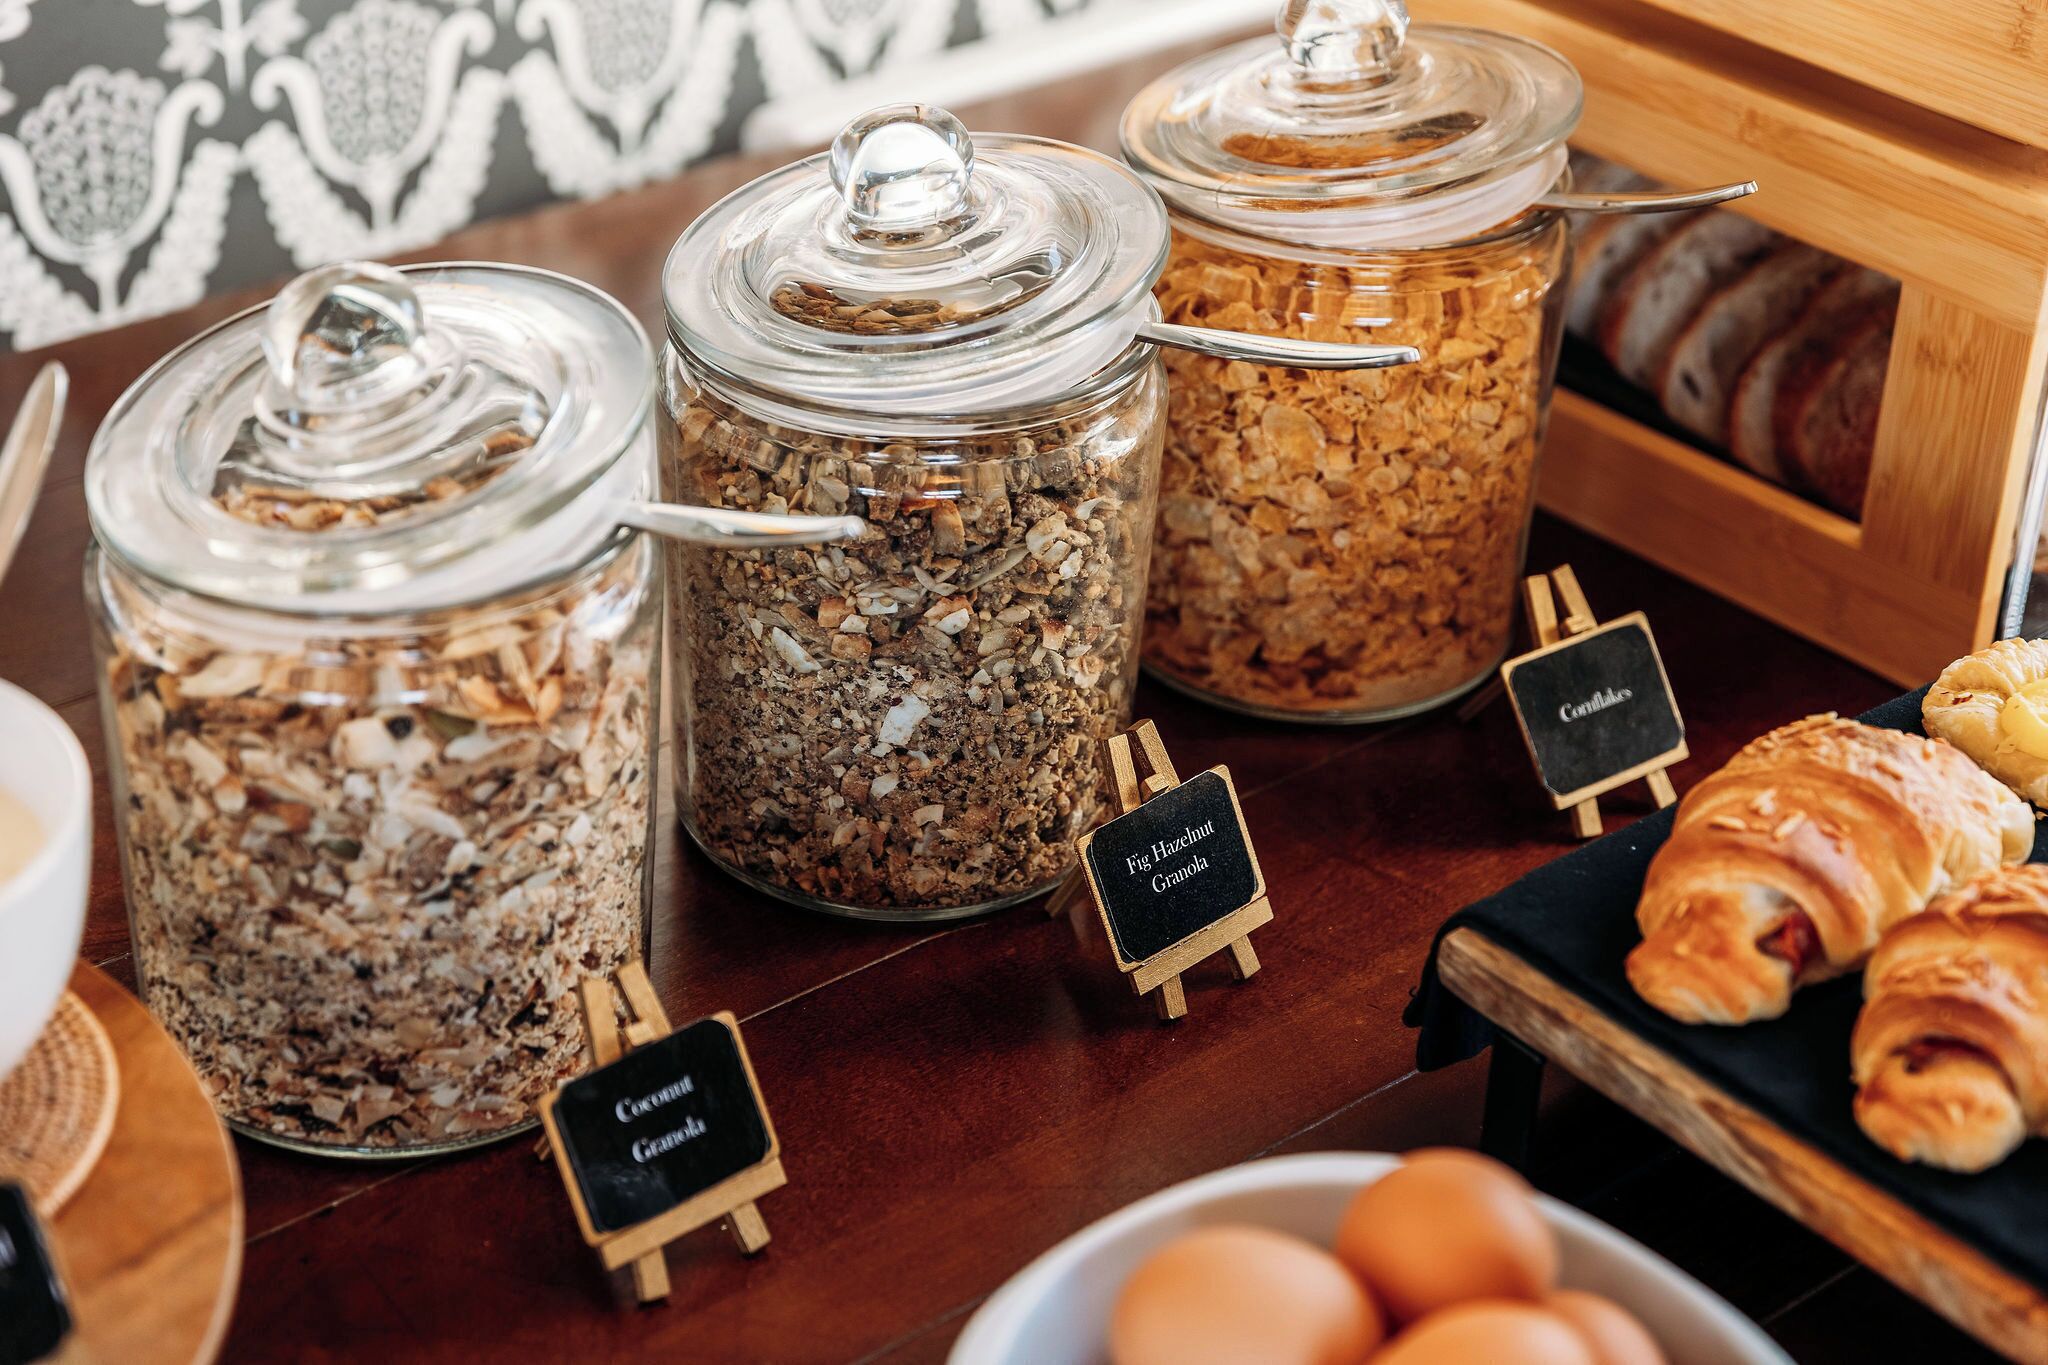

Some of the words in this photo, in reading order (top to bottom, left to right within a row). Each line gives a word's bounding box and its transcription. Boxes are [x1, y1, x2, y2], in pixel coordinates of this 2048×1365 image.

[1558, 687, 1633, 723] Cornflakes
[1126, 853, 1152, 876] Fig
[1151, 819, 1215, 863] Hazelnut
[1152, 855, 1209, 893] Granola
[615, 1074, 695, 1123] Coconut
[632, 1115, 707, 1163] Granola
